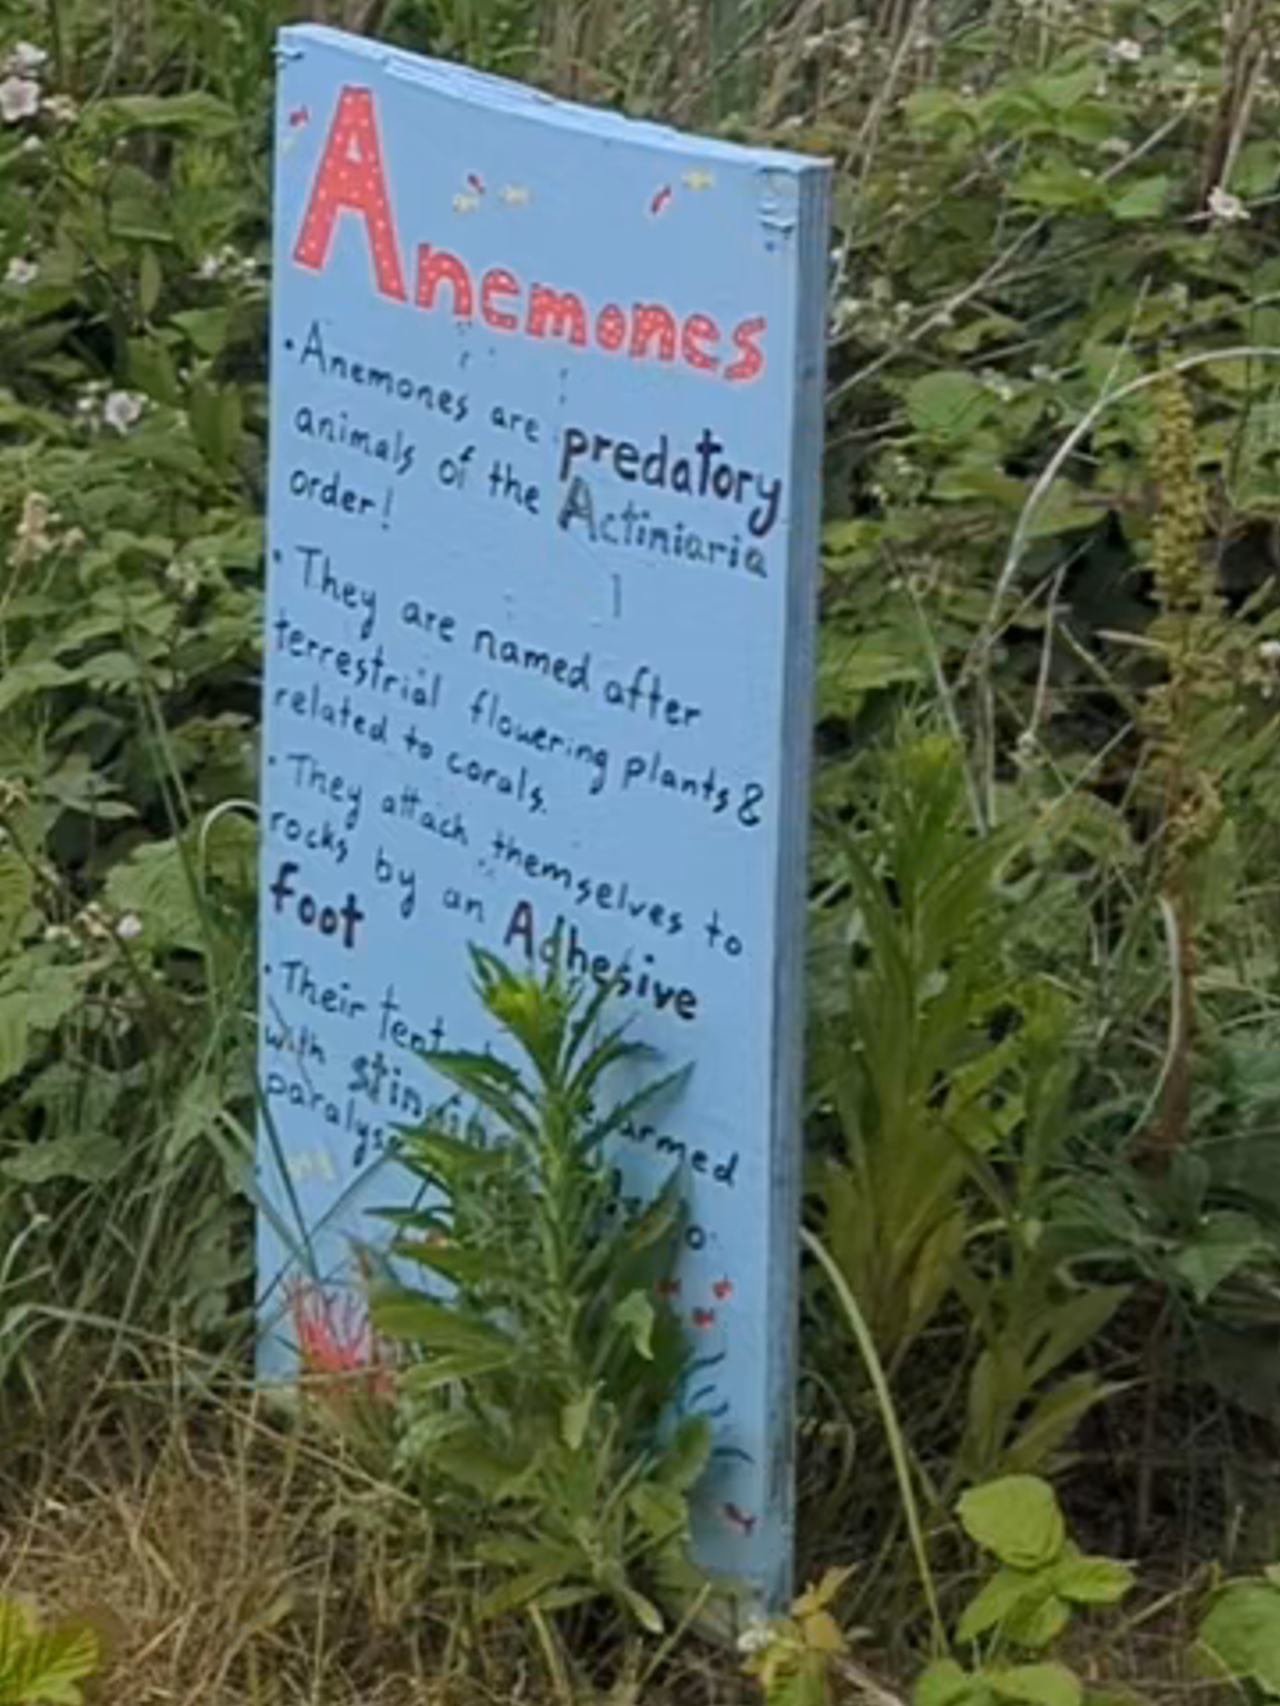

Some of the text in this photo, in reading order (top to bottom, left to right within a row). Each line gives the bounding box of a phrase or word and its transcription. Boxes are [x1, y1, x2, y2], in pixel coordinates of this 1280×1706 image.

[293, 84, 768, 382] Anemones
[288, 467, 393, 531] order!
[294, 405, 769, 579] animals of the Actiniaria
[299, 319, 784, 539] Anemones are predatory
[295, 545, 701, 729] They are named after
[272, 682, 548, 816] related to corals.
[273, 616, 443, 709] terrestrial
[469, 688, 610, 796] flowering
[620, 751, 731, 814] plants
[269, 809, 348, 863] rocks
[374, 848, 416, 919] by
[442, 886, 486, 924] an
[269, 862, 366, 950] foot
[286, 751, 744, 958] They attach themselves to
[264, 1024, 326, 1065] with
[280, 960, 368, 1020] Their
